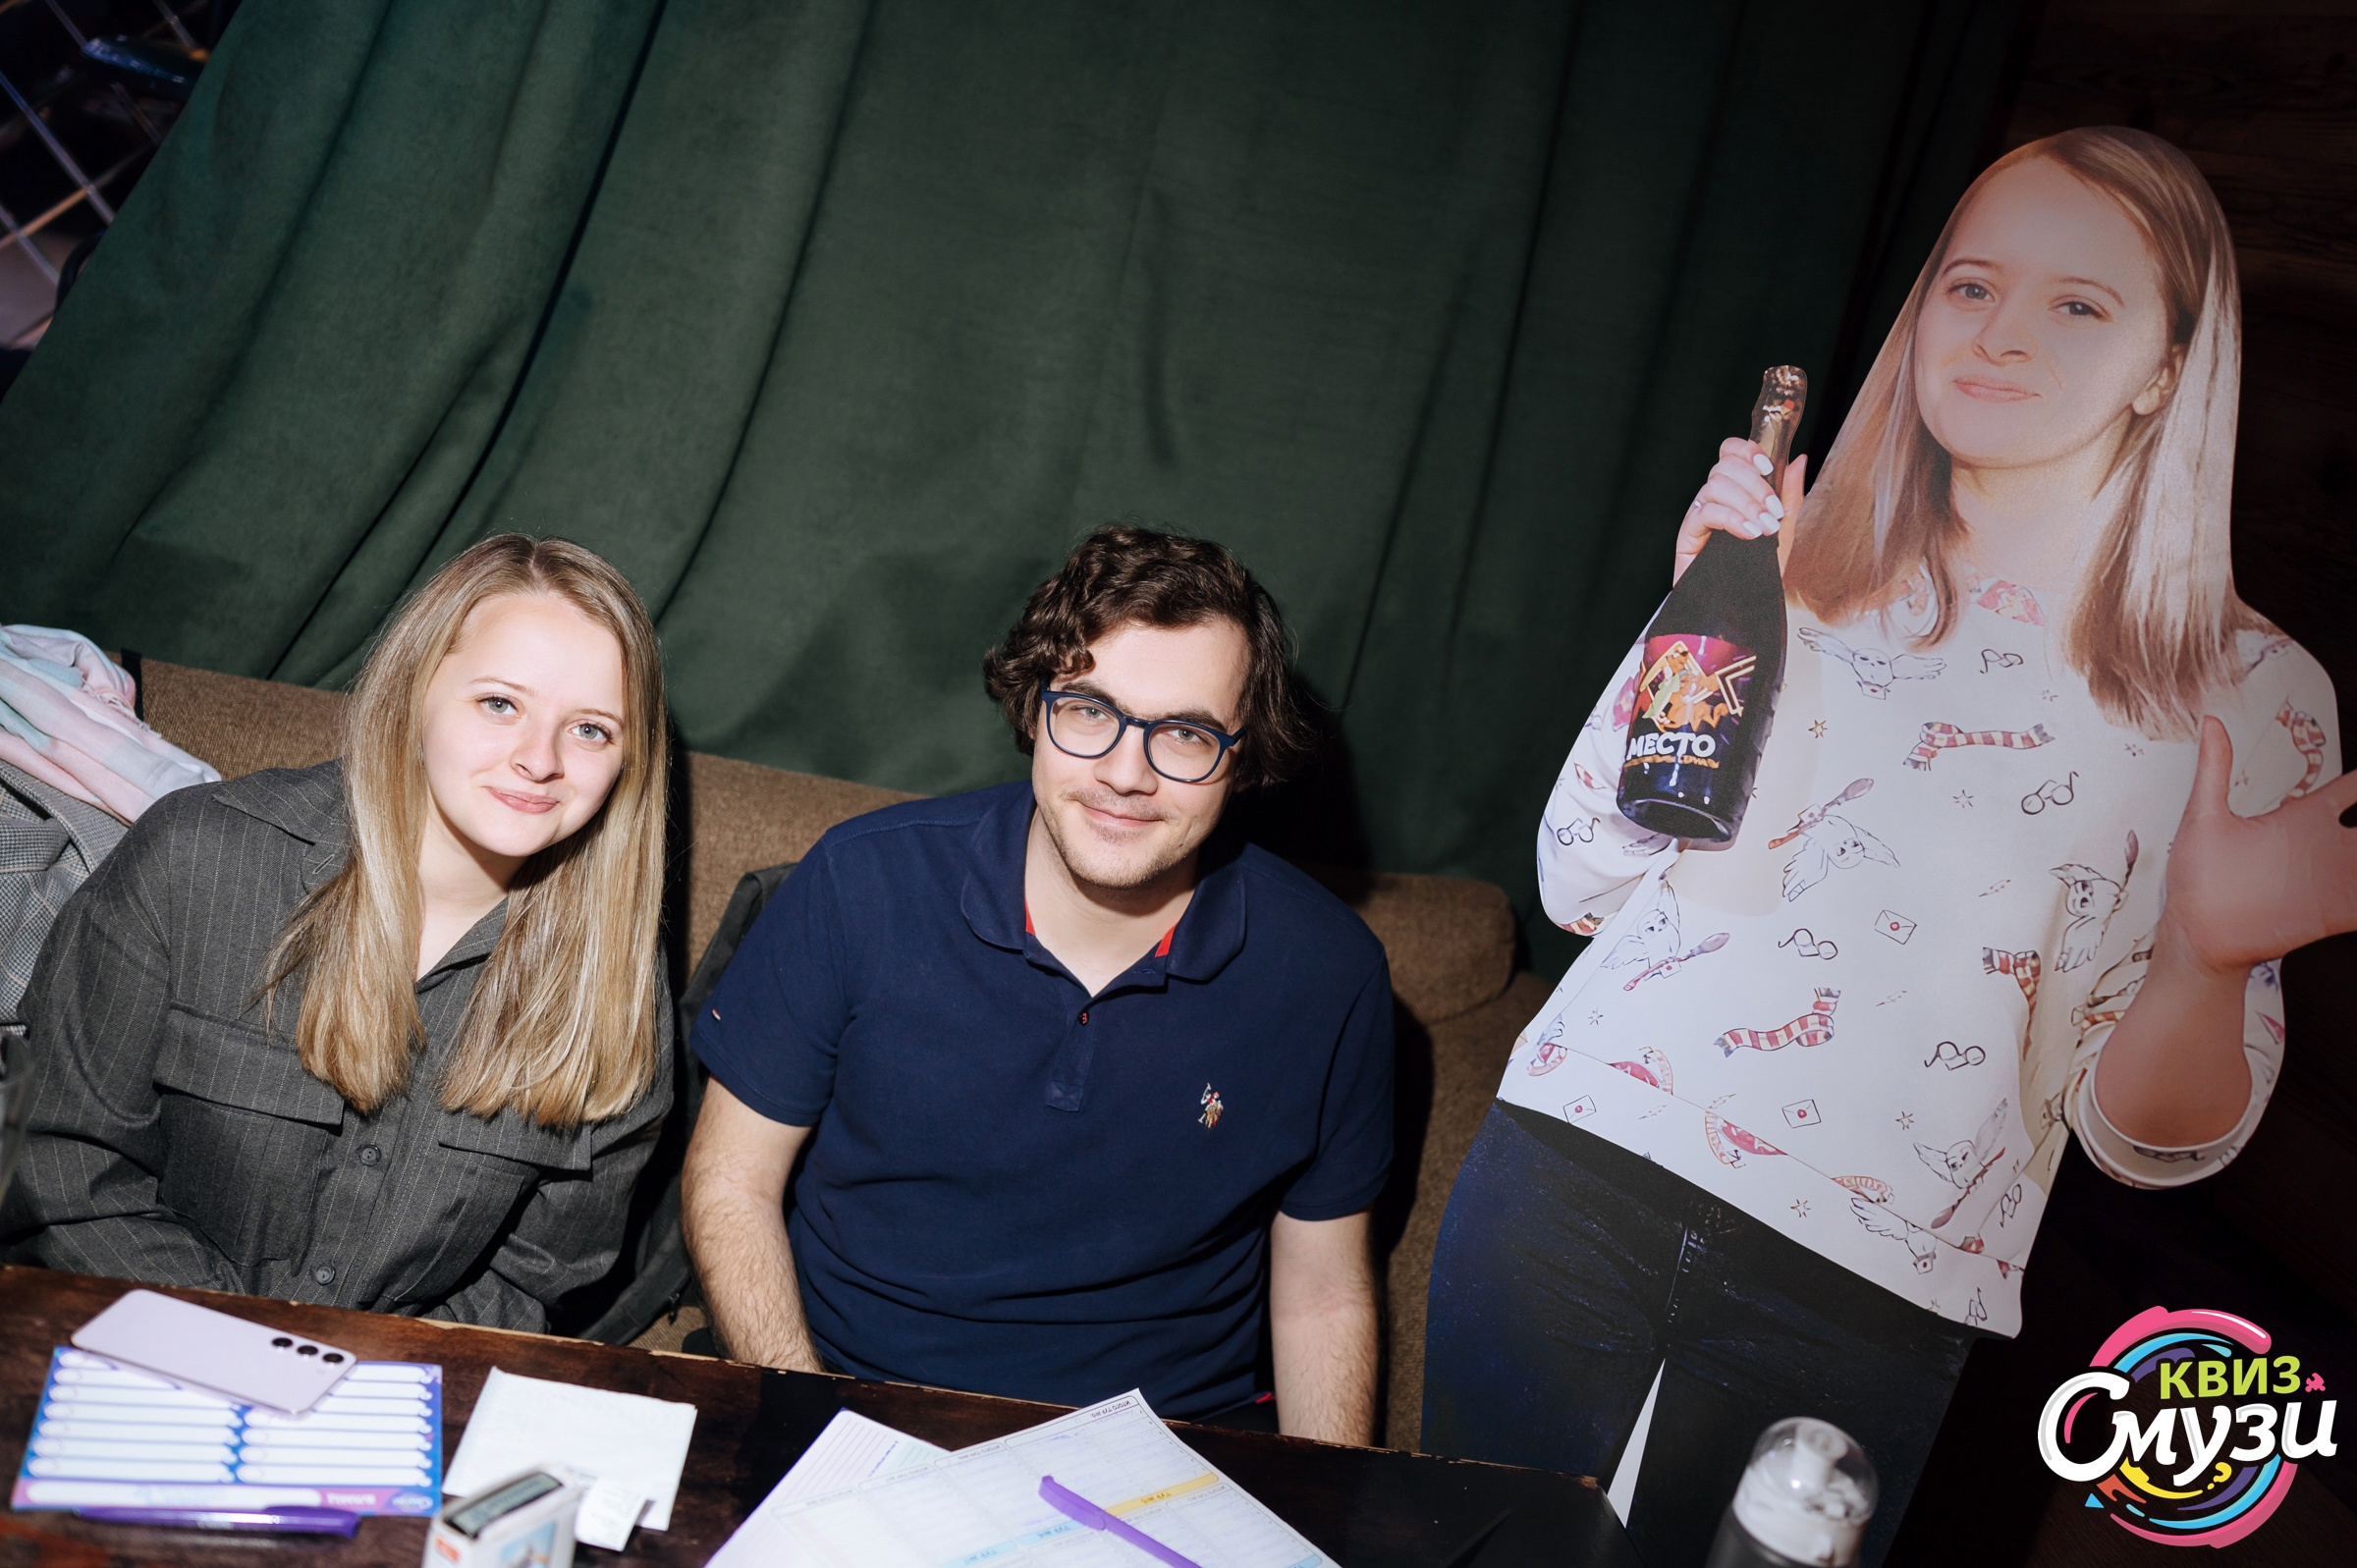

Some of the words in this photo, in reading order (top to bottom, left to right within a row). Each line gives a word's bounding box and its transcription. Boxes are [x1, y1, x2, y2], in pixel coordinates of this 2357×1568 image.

[1625, 731, 1717, 761] МЕСТО
[1101, 1405, 1113, 1415] ТУР
[1112, 1400, 1131, 1411] ИТОГО
